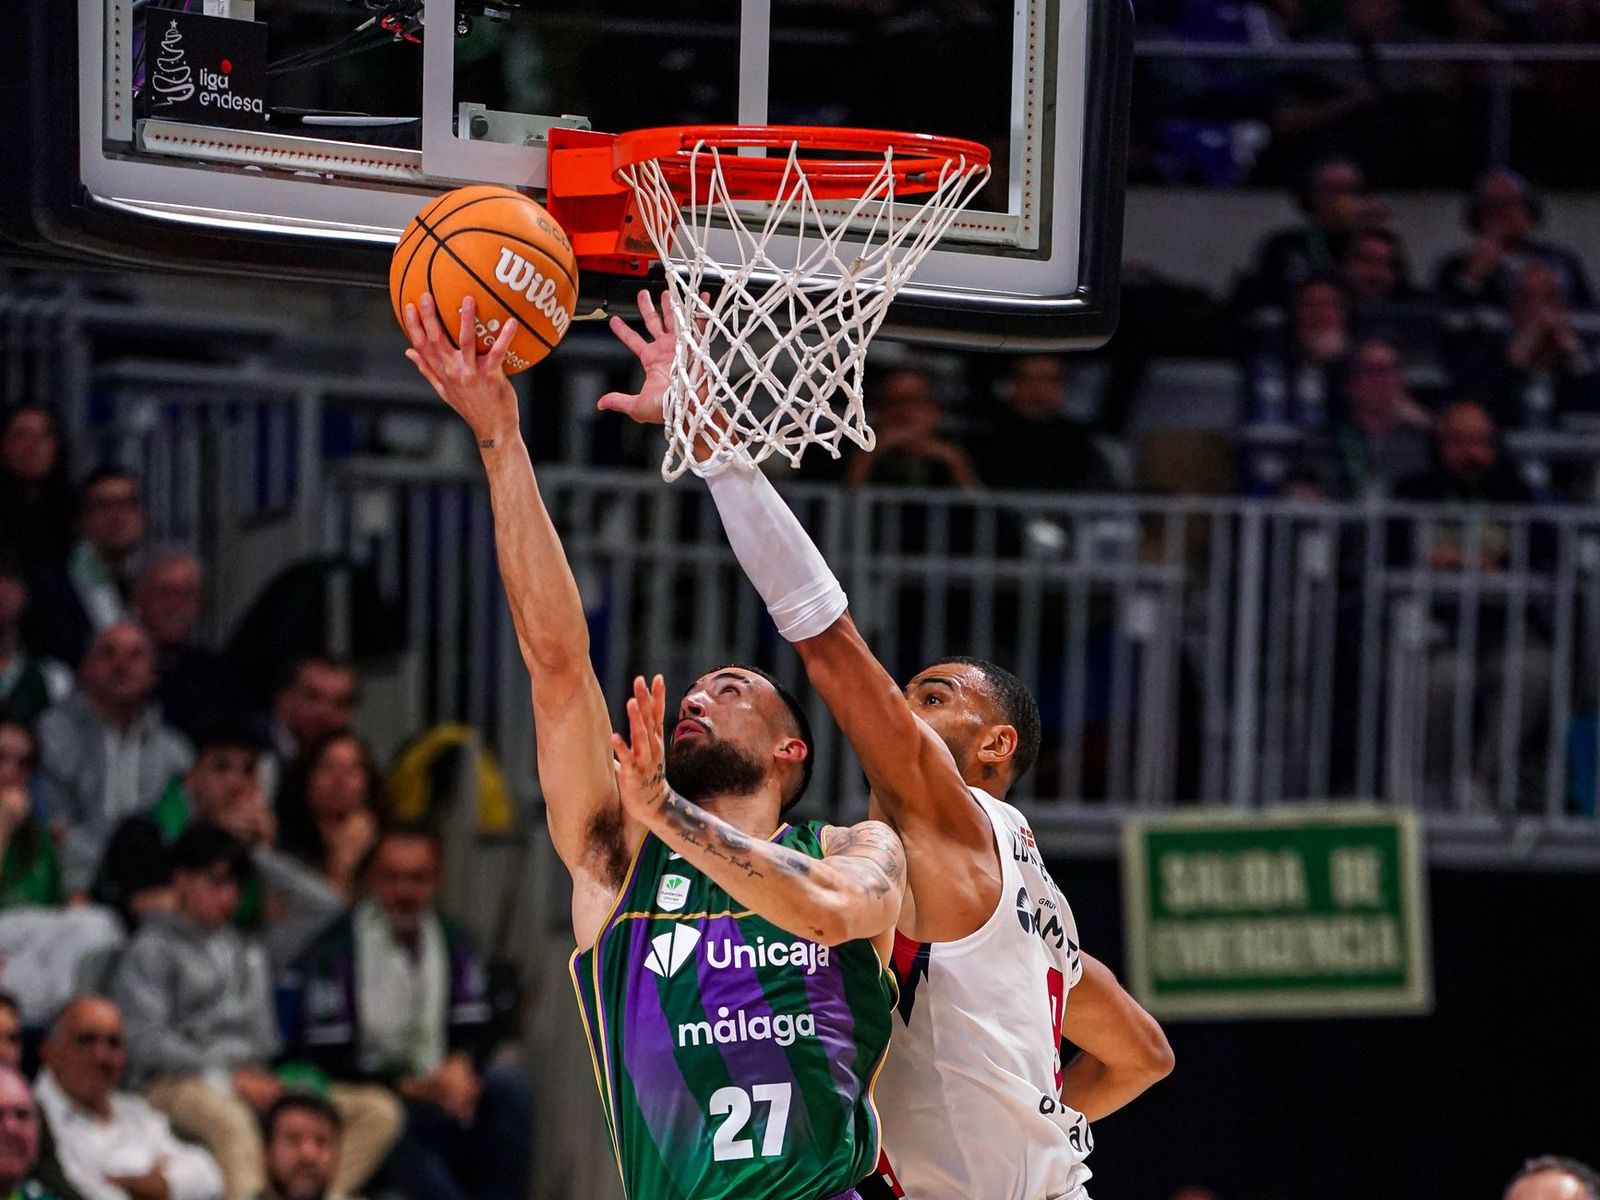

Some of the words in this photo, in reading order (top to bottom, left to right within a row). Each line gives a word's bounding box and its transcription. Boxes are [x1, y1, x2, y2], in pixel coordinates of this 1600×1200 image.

[199, 67, 229, 91] liga
[199, 91, 263, 114] endesa
[494, 246, 571, 339] Wilson
[706, 936, 830, 976] Unicaja
[709, 1082, 792, 1162] 27
